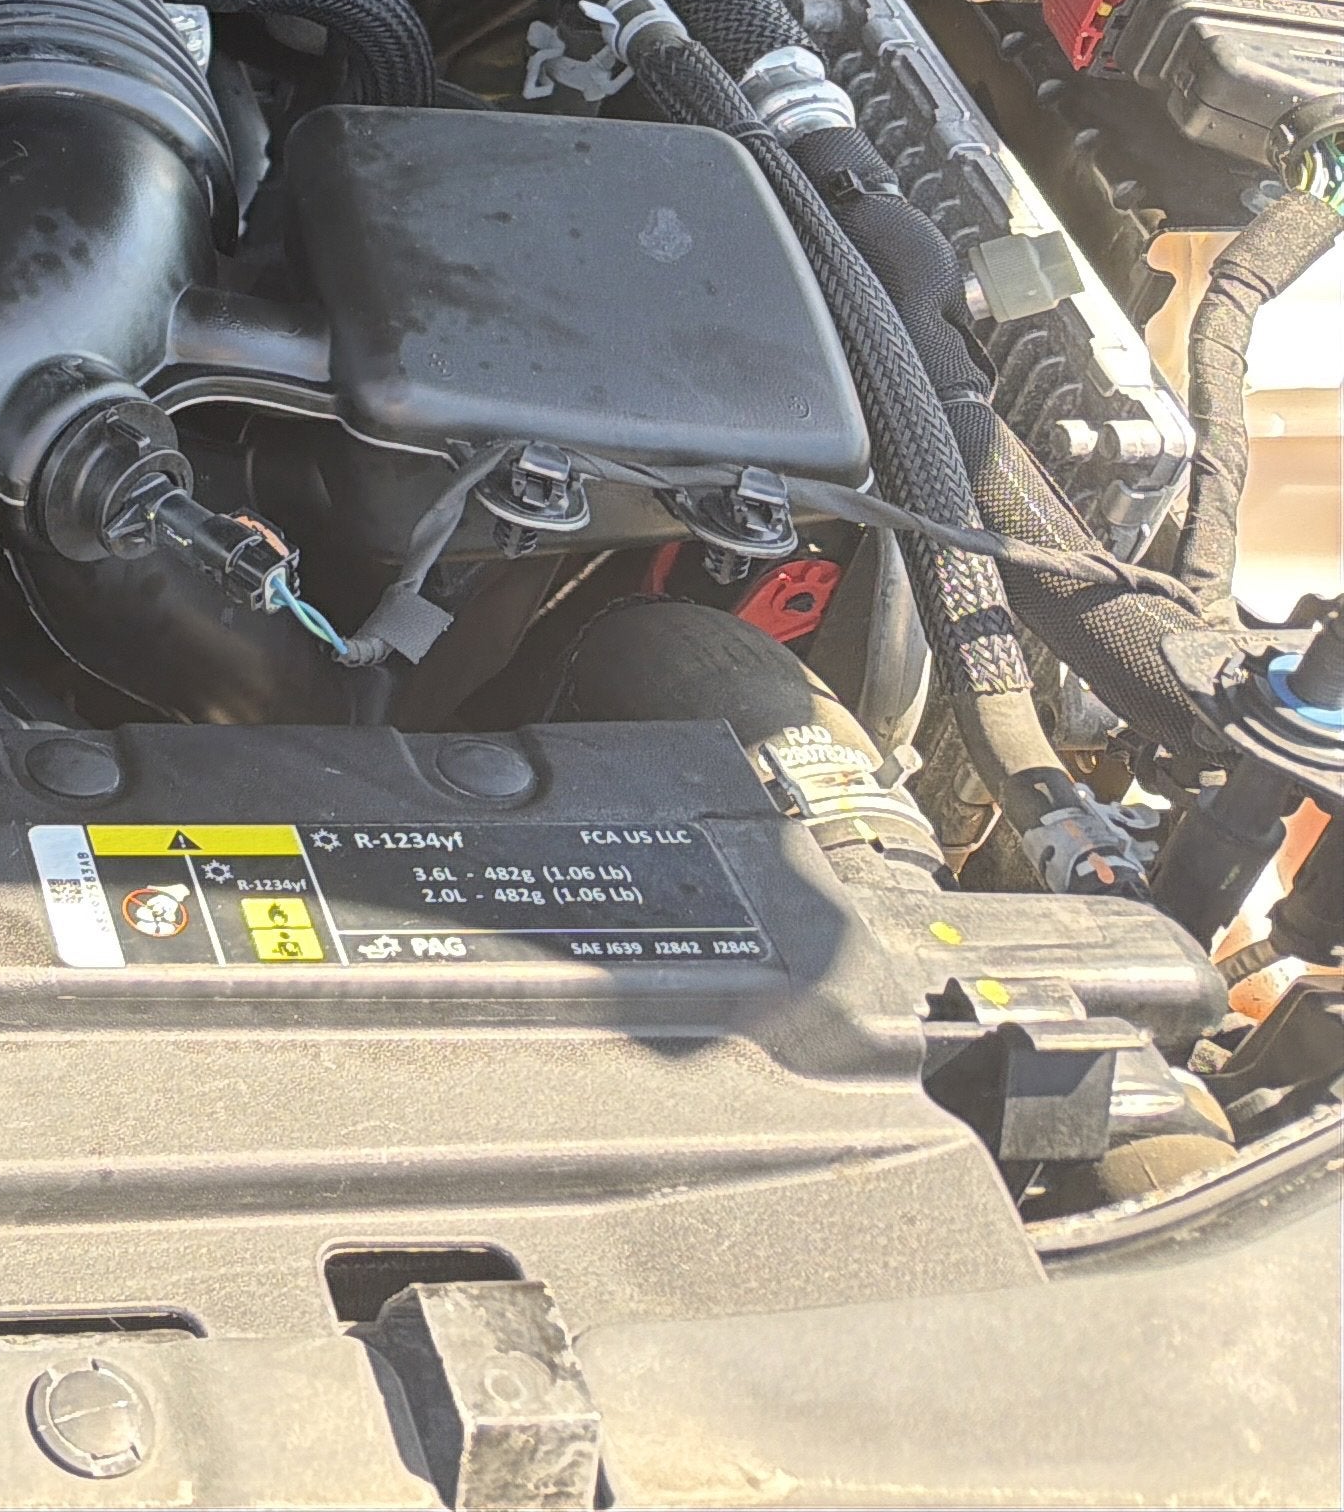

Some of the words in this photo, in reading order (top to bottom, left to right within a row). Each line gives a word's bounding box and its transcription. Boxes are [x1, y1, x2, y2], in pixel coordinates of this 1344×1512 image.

[782, 725, 832, 745] RAD
[354, 832, 464, 852] R-1234yf
[580, 830, 622, 844] FCA
[623, 830, 653, 844] US
[656, 830, 692, 844] LLC
[412, 867, 458, 882] 3.6L
[484, 866, 535, 883] 482g
[542, 865, 596, 883] (1.06
[598, 864, 633, 883] Lb)
[236, 879, 308, 893] R-1234yf
[421, 888, 467, 903] 2.0L
[494, 888, 546, 905] 482g
[552, 887, 607, 905] (1.06
[611, 886, 643, 905] Lb)
[411, 937, 467, 957] PAG
[570, 942, 603, 955] SAE
[606, 941, 643, 955] J639
[654, 941, 702, 955] J2842
[712, 940, 761, 954] J2845
